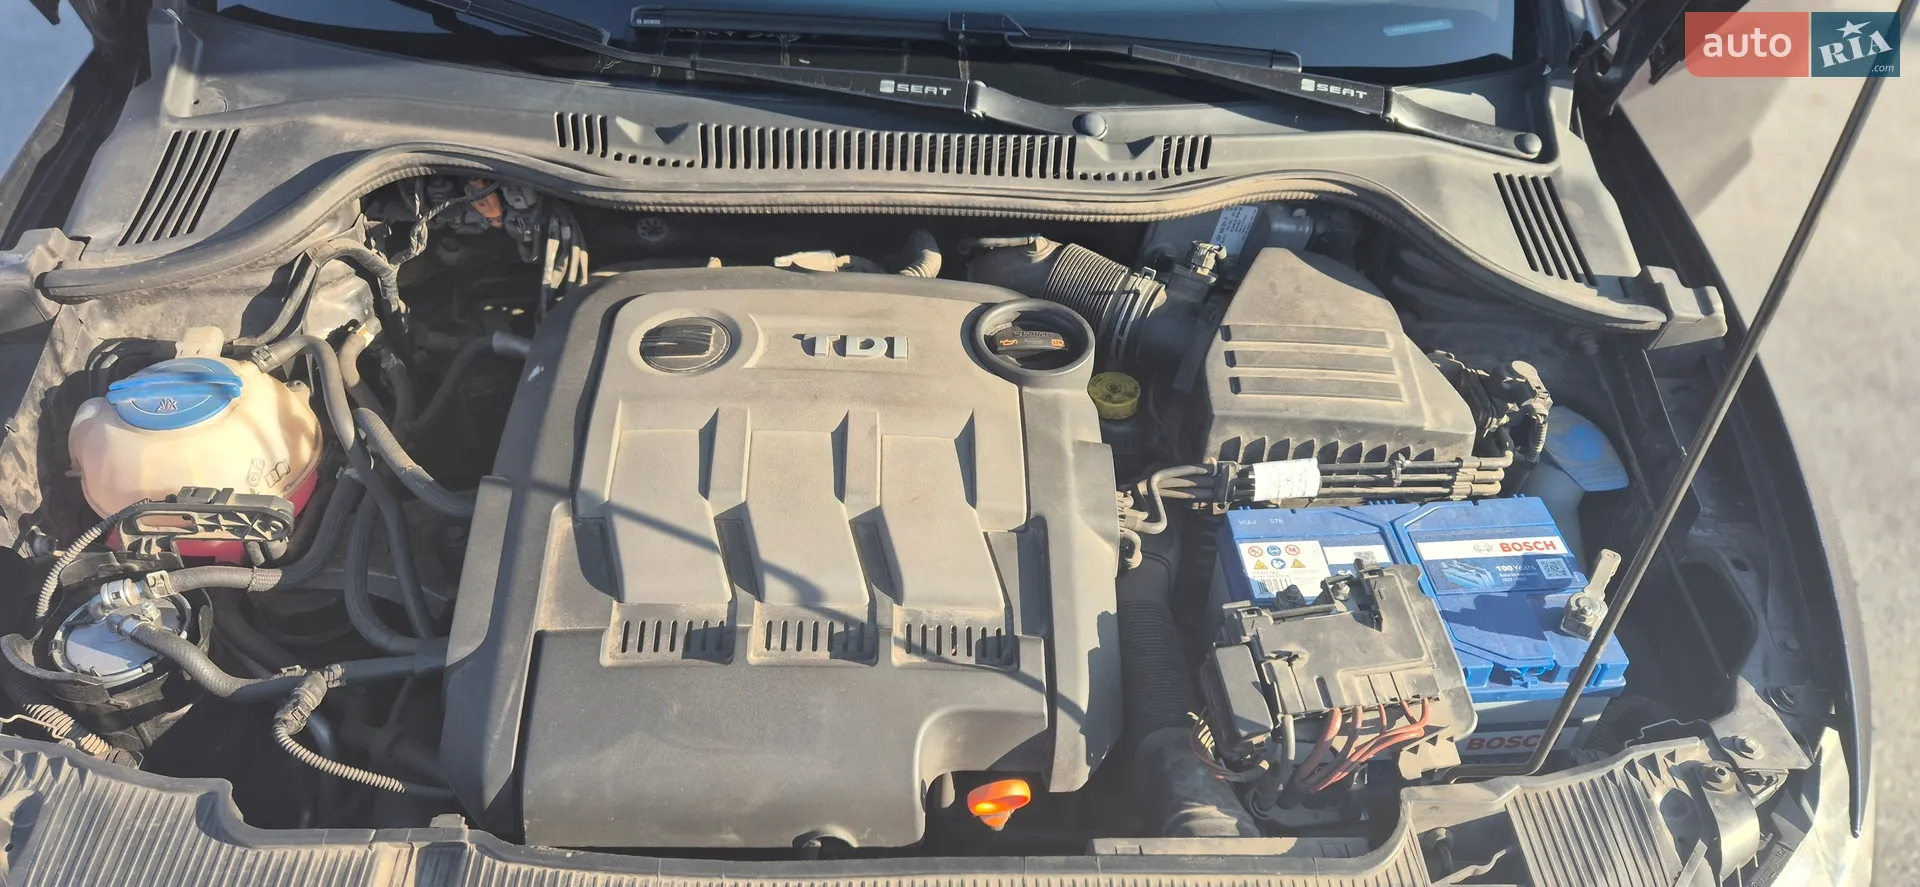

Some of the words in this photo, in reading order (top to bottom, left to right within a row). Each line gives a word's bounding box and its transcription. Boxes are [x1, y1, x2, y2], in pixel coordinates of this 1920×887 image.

[896, 83, 952, 96] SEAT
[1316, 83, 1368, 99] SEAT
[800, 334, 909, 359] TDI
[1499, 540, 1557, 553] BOSCH
[1495, 564, 1514, 572] 100
[1466, 732, 1560, 751] BOSC
